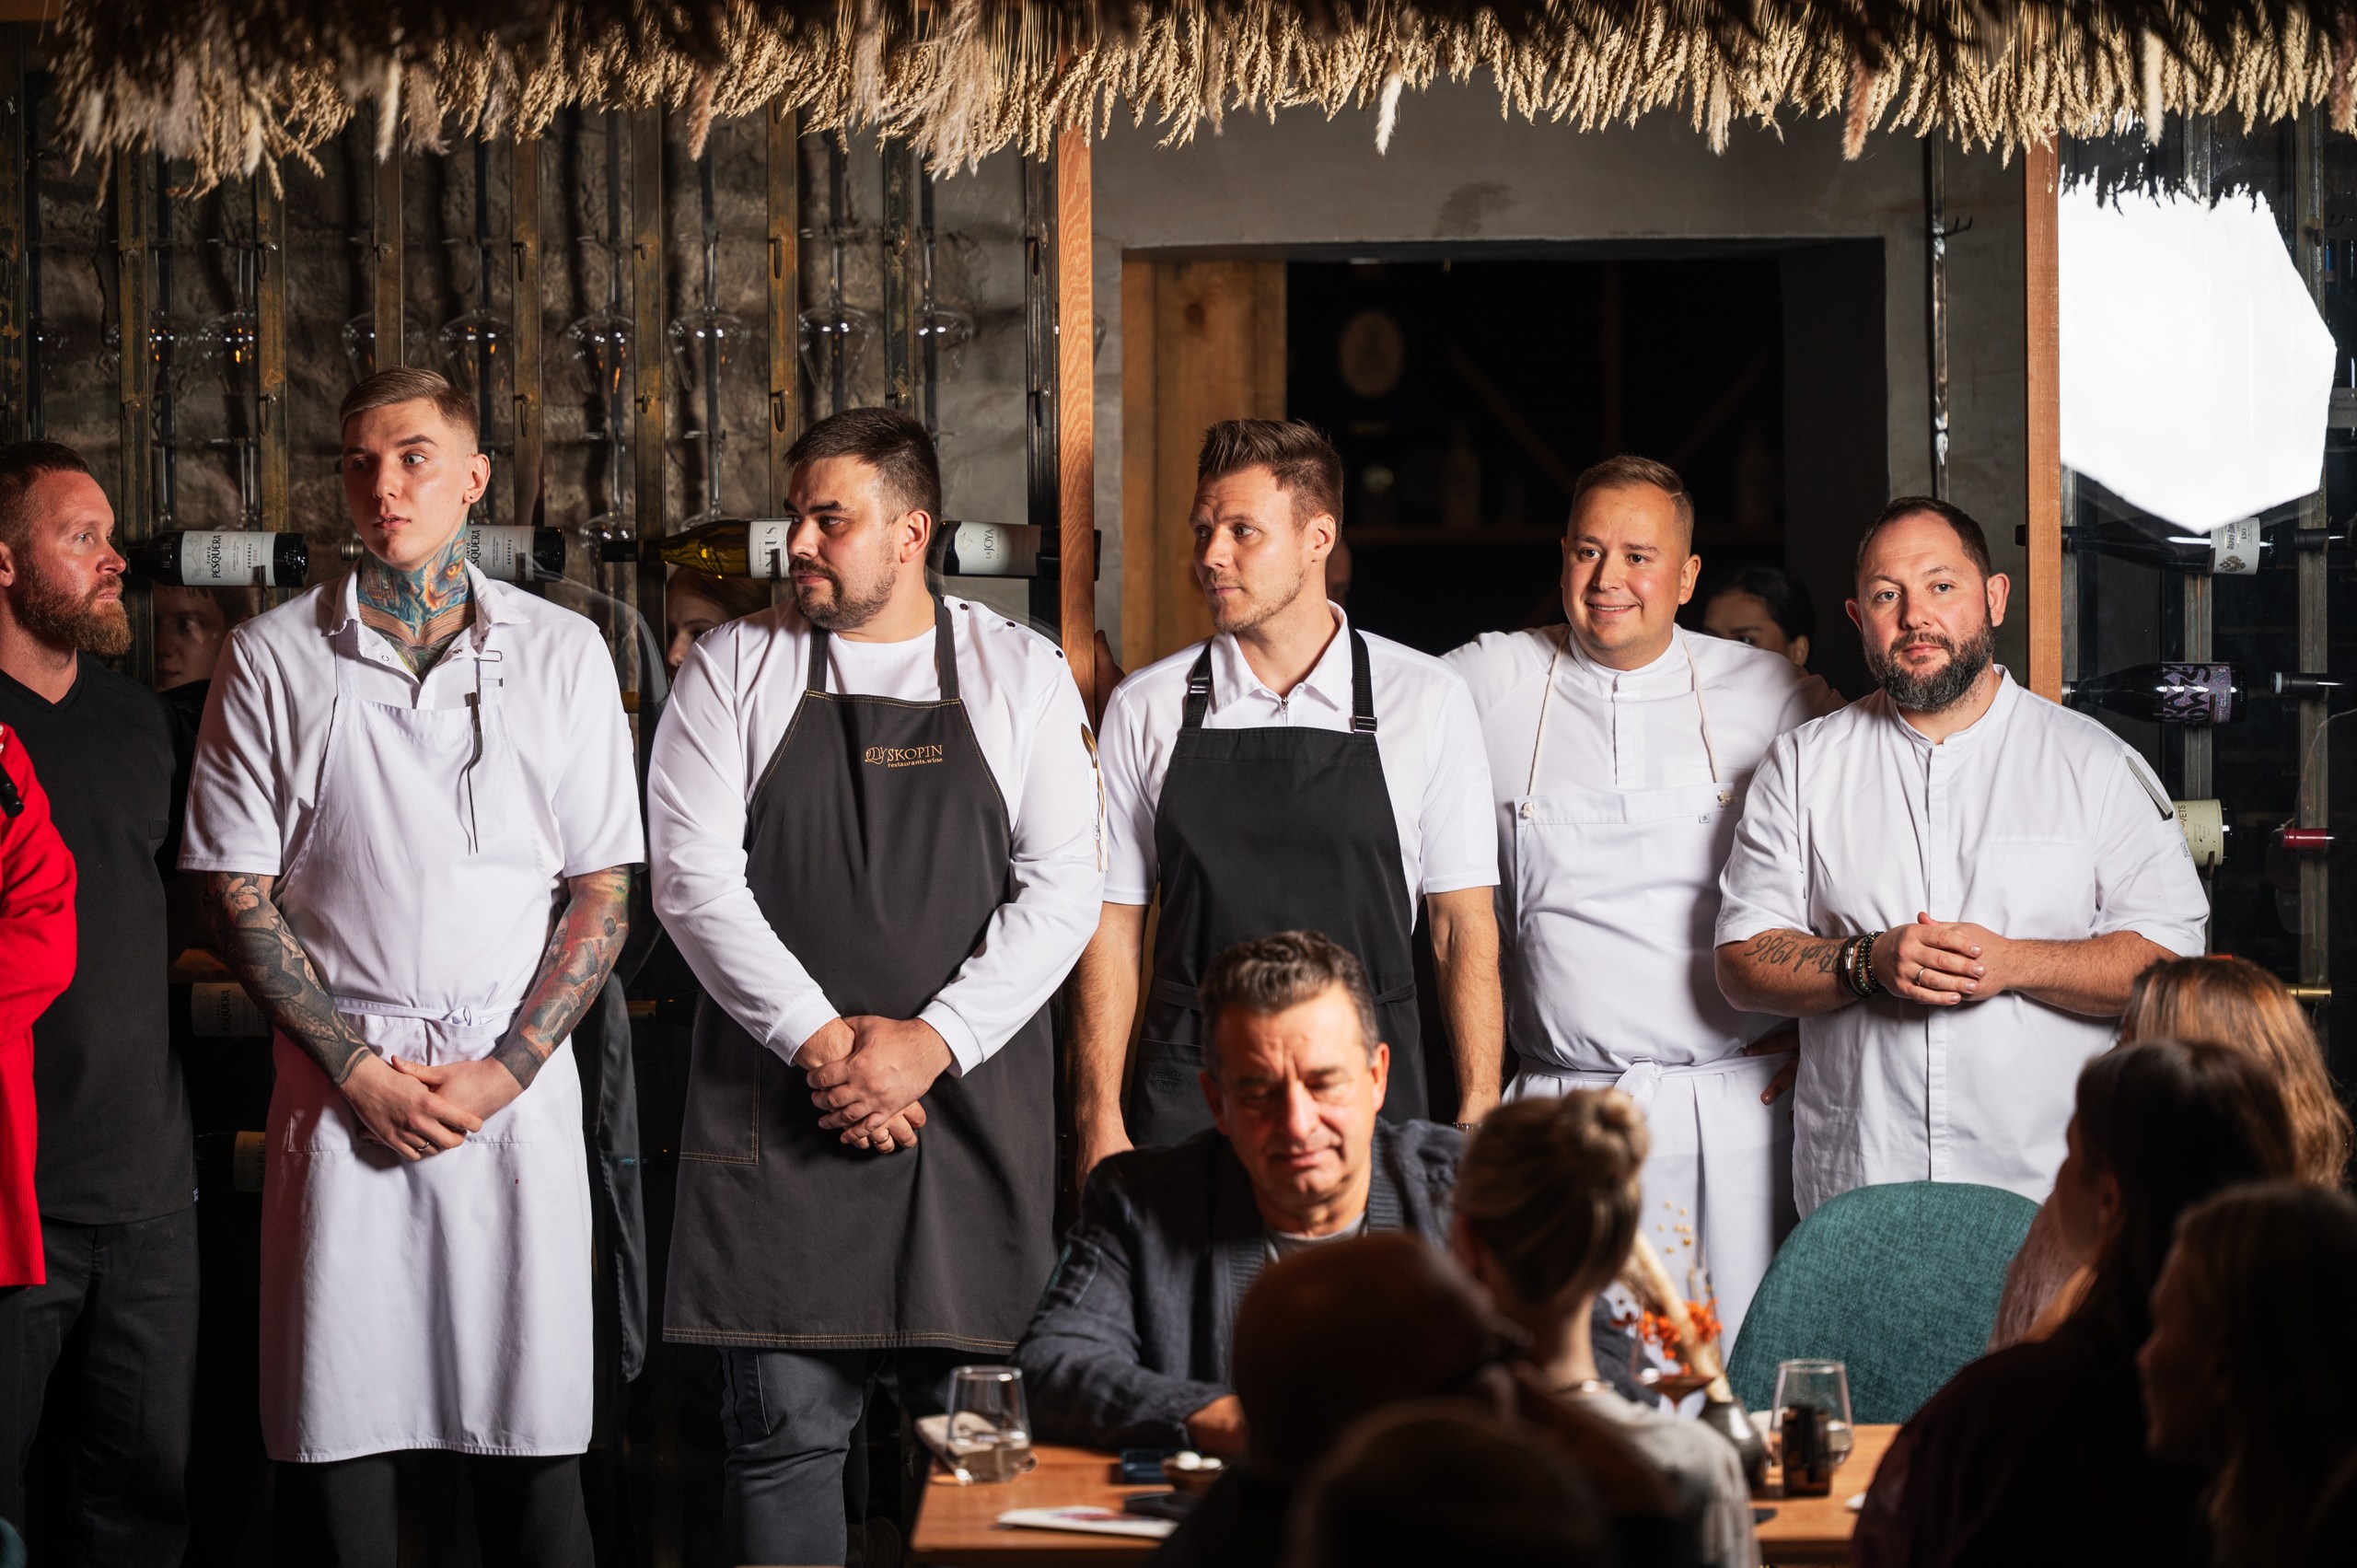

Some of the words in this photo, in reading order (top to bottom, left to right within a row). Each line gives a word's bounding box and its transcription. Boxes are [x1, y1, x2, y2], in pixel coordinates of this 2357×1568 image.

[470, 529, 481, 568] SQUERA
[983, 528, 994, 552] JOYA
[211, 535, 222, 578] PESQUERA
[887, 745, 943, 762] SKOPIN
[888, 757, 943, 768] restaurants.wine
[1744, 935, 1798, 967] 1986
